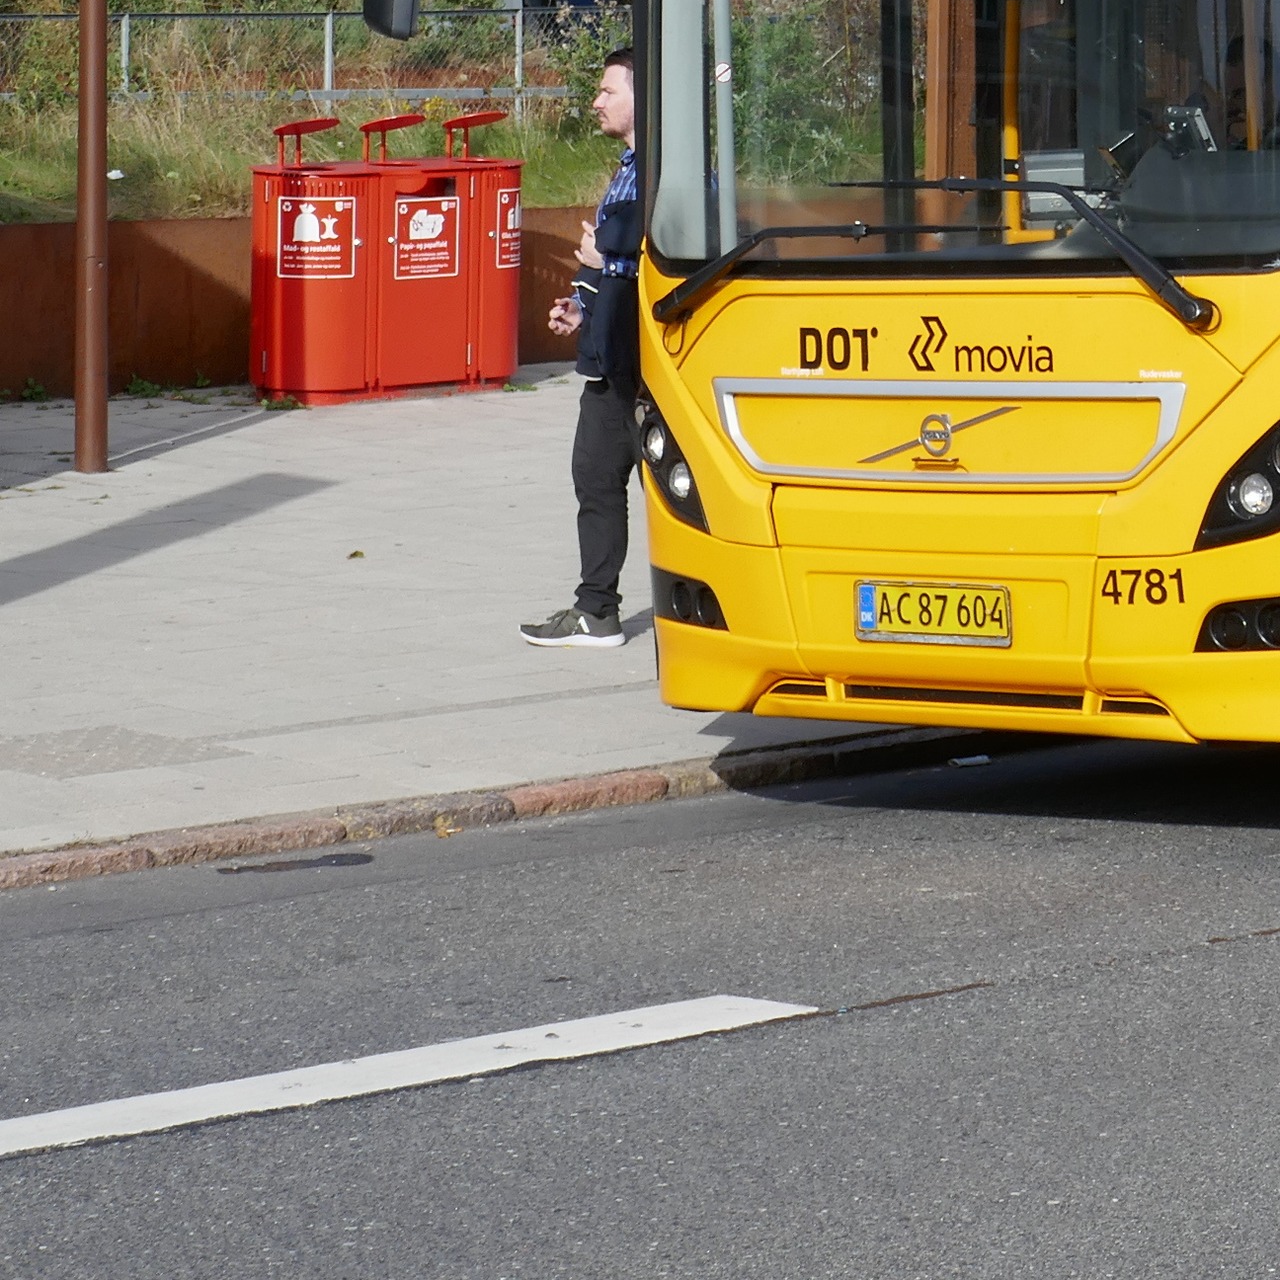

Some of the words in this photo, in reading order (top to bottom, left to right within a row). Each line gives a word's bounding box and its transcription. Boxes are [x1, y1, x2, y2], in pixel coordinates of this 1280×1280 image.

[300, 245, 309, 254] og
[310, 244, 341, 253] restaffald
[799, 326, 879, 372] DOT
[954, 335, 1054, 373] movia
[1101, 568, 1186, 605] 4781
[861, 611, 874, 624] DK
[878, 592, 912, 624] AC
[918, 593, 949, 627] 87
[956, 594, 1004, 630] 604
